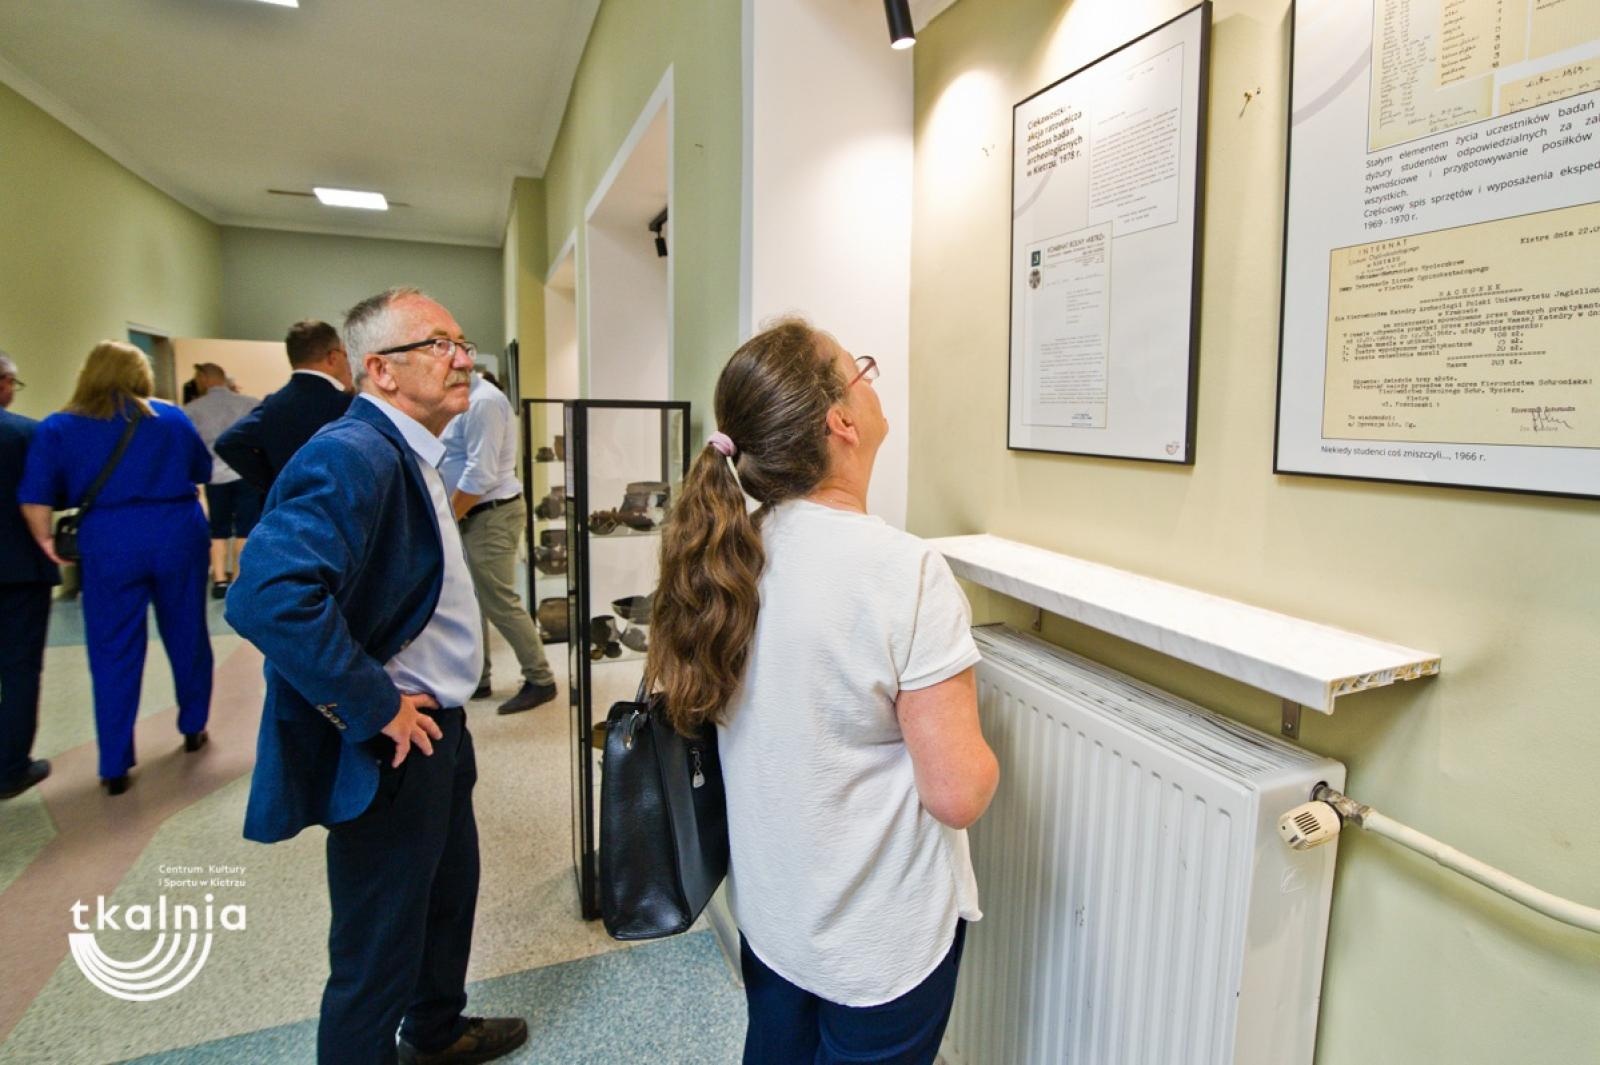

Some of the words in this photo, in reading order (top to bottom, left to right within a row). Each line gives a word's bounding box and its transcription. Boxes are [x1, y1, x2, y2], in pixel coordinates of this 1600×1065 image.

[1045, 111, 1082, 132] ratownicza
[1366, 156, 1392, 168] Stałym
[1399, 141, 1448, 159] elementem
[1455, 133, 1478, 145] życia
[1486, 114, 1550, 136] uczestników
[1558, 99, 1594, 117] badań
[1027, 139, 1052, 155] podczas
[1027, 135, 1083, 165] archeologicznych
[1366, 168, 1392, 181] dyżury
[1401, 154, 1447, 171] studentów
[1456, 128, 1547, 158] odpowiedzialnych
[1560, 122, 1572, 132] za
[1364, 175, 1418, 193] żywnościowe
[1429, 170, 1432, 178] i
[1443, 148, 1528, 176] przygotowywanie
[1542, 132, 1592, 153] posiłków
[1363, 204, 1405, 219] Częściowy
[1409, 199, 1425, 208] spis
[1431, 189, 1473, 205] sprzętów
[1487, 171, 1553, 192] wyposażenia
[1364, 189, 1408, 206] wszystkich.
[1363, 219, 1383, 230] 1969
[1390, 214, 1410, 225] 1970
[1553, 231, 1574, 239] dnia
[1358, 239, 1407, 254] INTERNAT
[1495, 293, 1550, 304] Uniwersytetu
[1321, 446, 1352, 456] Niekiedy
[1353, 447, 1385, 456] studenci
[1388, 447, 1402, 456] coś
[1455, 452, 1477, 461] 1966
[1479, 453, 1486, 461] r.
